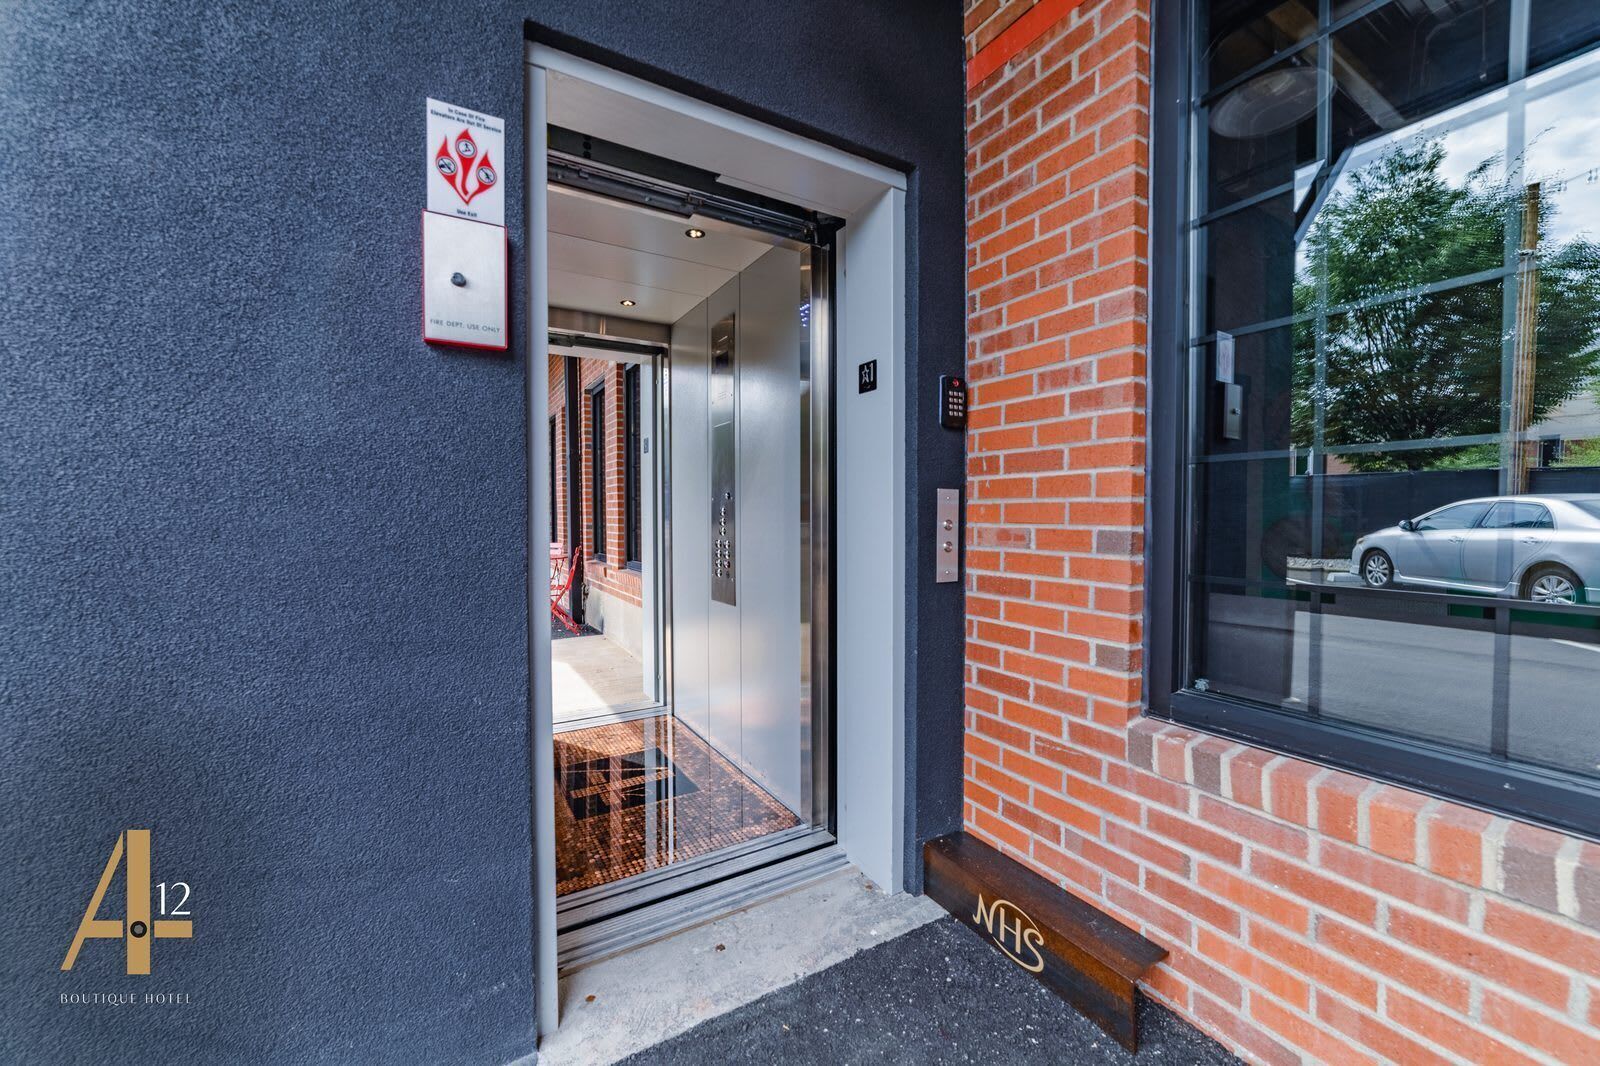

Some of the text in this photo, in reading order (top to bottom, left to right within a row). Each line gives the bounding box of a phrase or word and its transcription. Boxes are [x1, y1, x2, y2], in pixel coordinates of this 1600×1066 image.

[454, 109, 467, 117] Case
[430, 109, 455, 121] Elevators
[456, 116, 465, 124] Are
[483, 123, 502, 133] Service
[456, 208, 477, 218] Use Exit
[430, 319, 501, 334] FIRE DEPT. USE ONLY
[972, 893, 1045, 973] NHS
